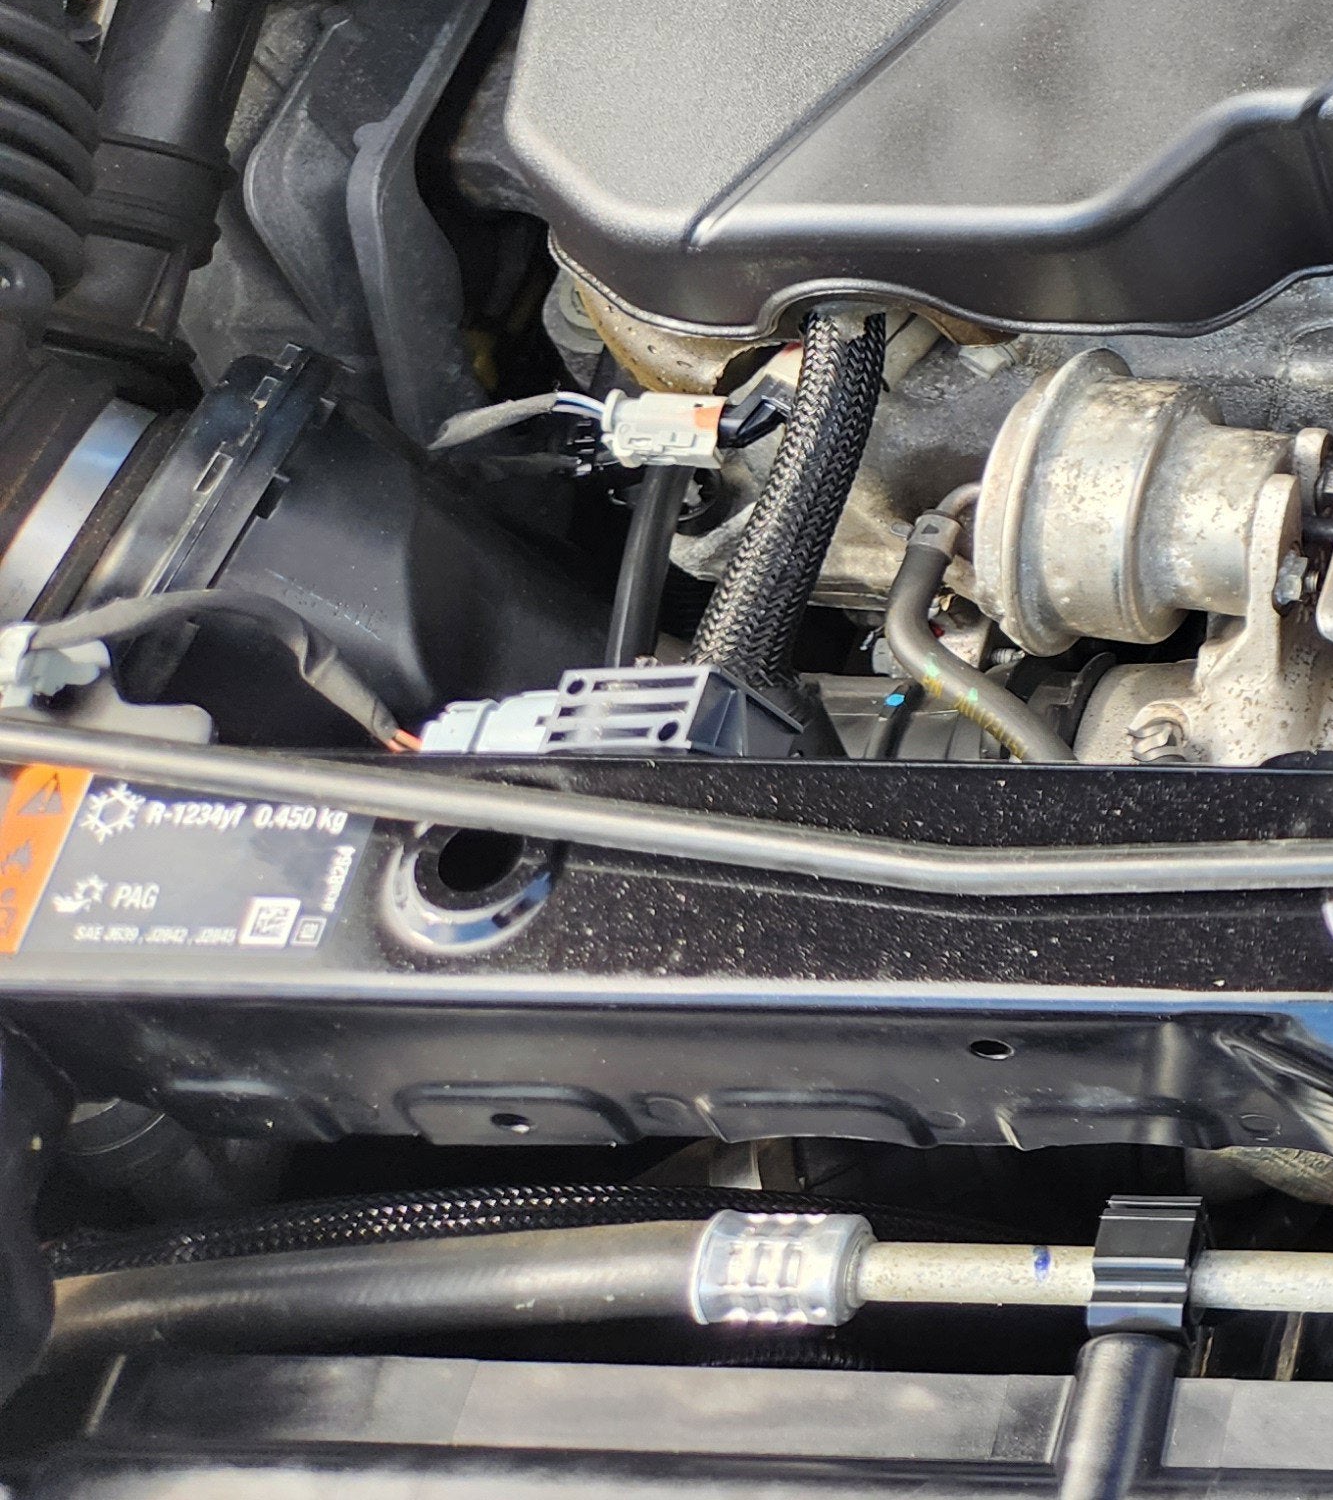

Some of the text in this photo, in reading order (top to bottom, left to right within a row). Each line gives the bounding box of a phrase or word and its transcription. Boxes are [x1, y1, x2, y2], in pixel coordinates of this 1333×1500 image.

[145, 800, 349, 836] R-1234yf 0.450 kg
[112, 882, 160, 911] PAG
[73, 925, 104, 943] SAE
